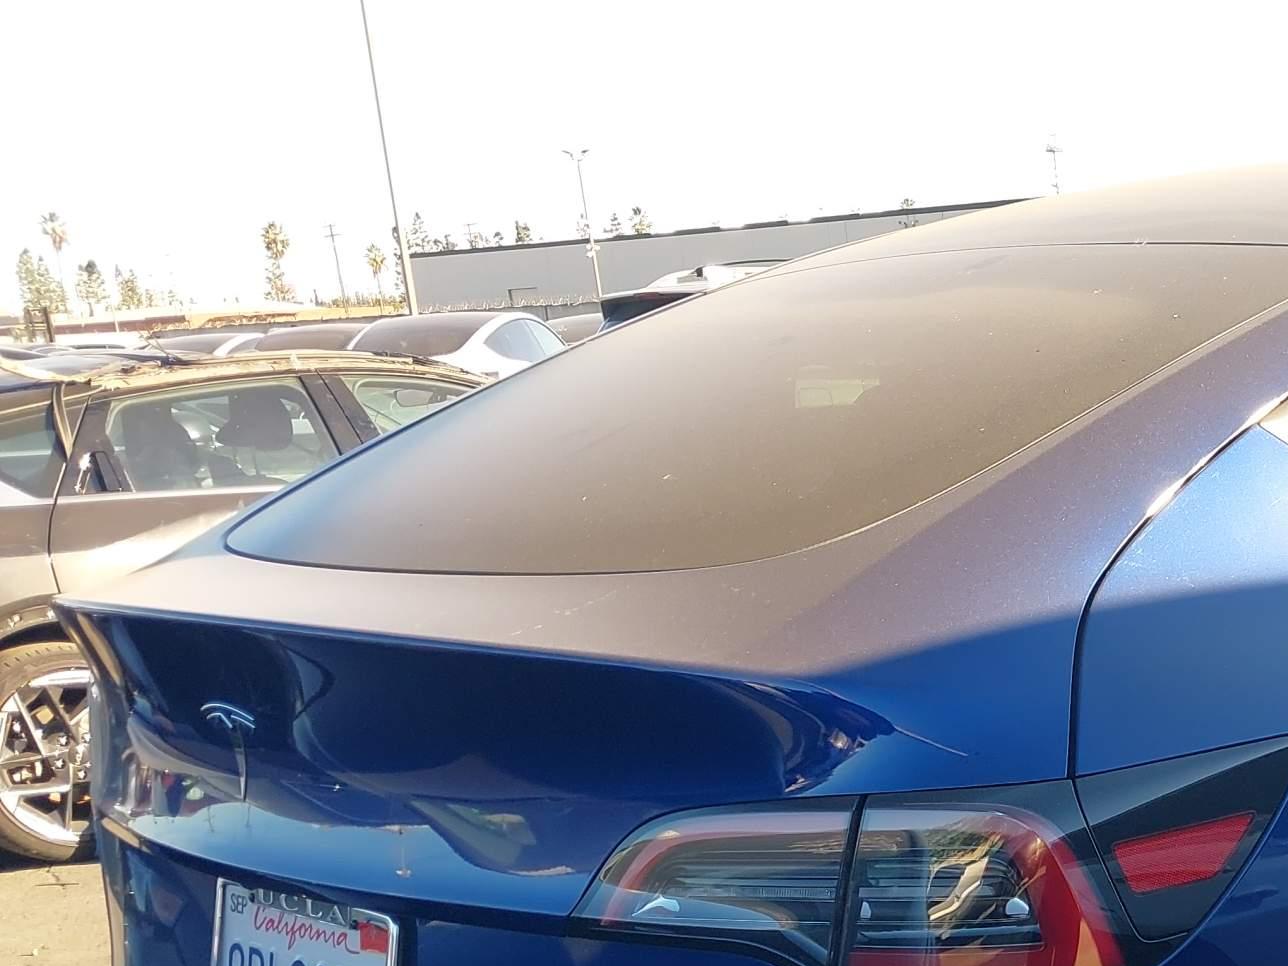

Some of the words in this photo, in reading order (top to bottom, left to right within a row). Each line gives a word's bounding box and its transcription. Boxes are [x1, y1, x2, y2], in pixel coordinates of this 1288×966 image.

[230, 892, 248, 914] SEP
[256, 888, 347, 926] UCLA
[253, 905, 360, 955] California
